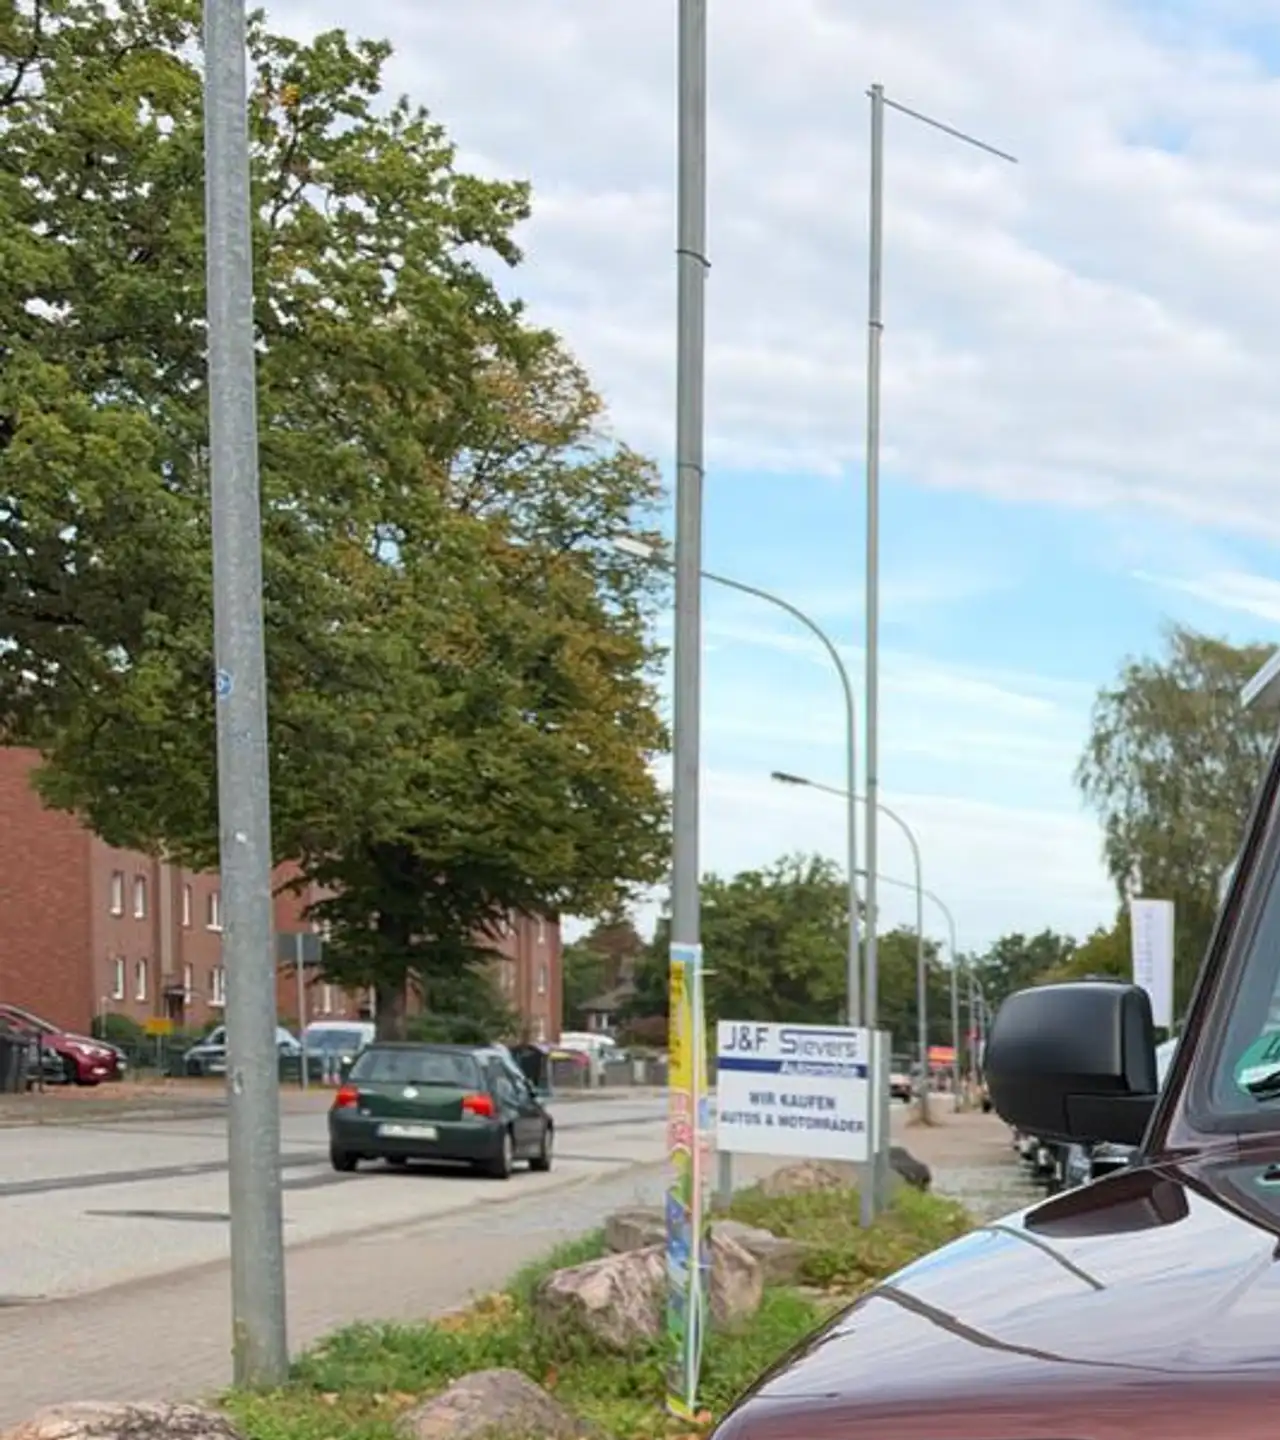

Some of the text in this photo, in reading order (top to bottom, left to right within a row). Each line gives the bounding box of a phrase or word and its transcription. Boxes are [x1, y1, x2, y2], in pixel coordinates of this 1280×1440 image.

[723, 1025, 857, 1059] J&F Sievers
[749, 1091, 836, 1110] WIR KAUFEN
[721, 1111, 762, 1127] AUTOS
[765, 1114, 774, 1127] &
